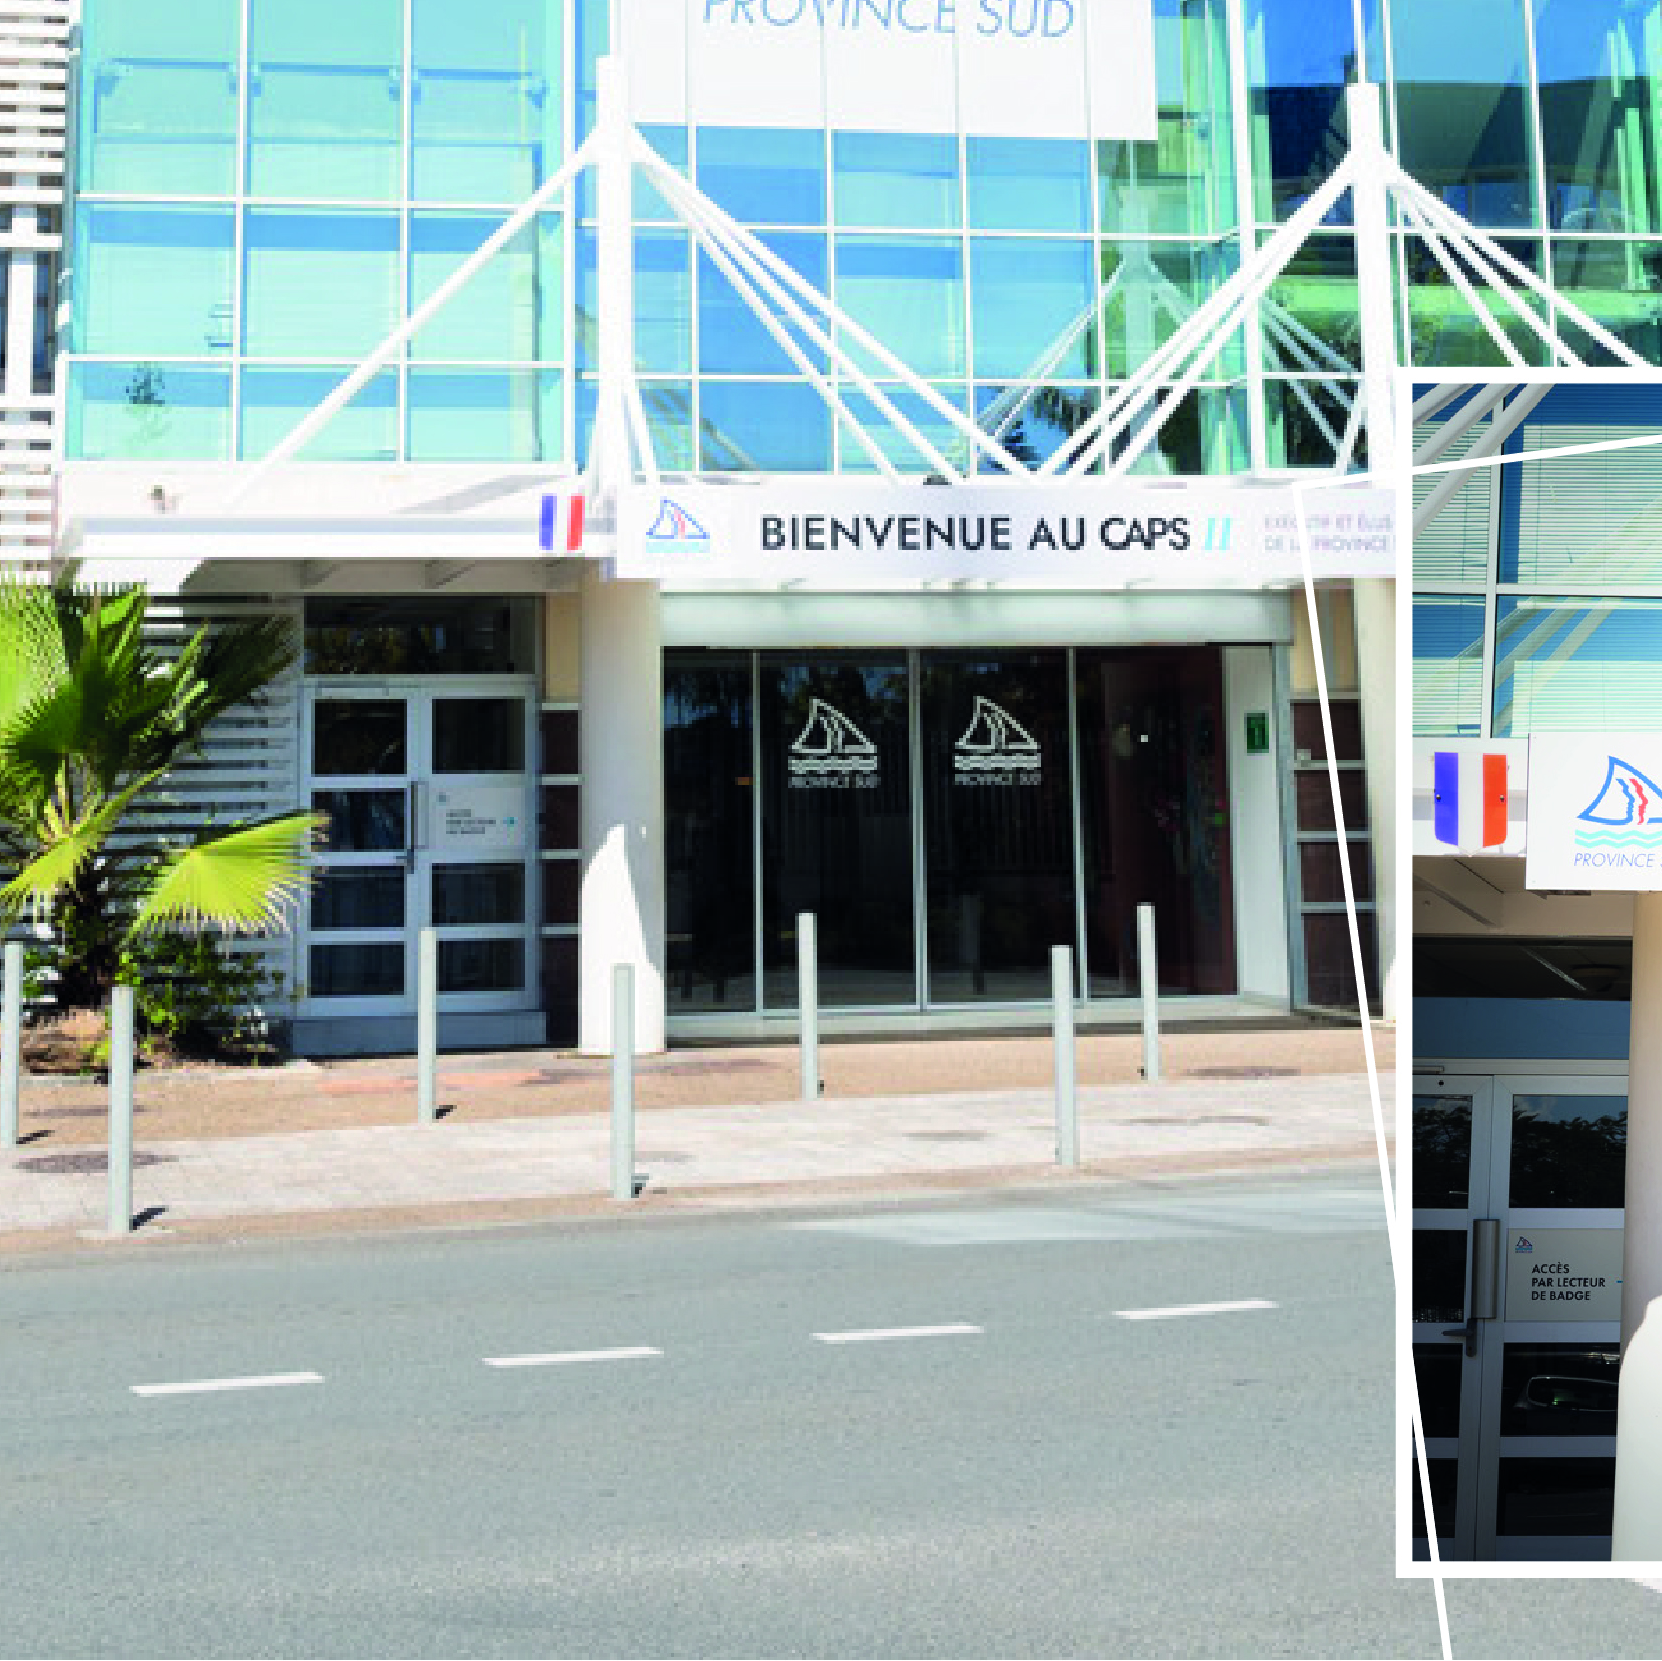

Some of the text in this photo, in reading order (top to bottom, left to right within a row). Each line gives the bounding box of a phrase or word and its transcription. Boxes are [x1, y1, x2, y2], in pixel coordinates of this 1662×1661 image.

[760, 515, 1012, 550] BIENVENUE
[1028, 516, 1086, 550] AU
[1099, 516, 1190, 550] CAPS
[1573, 853, 1656, 867] PROVINCE
[1531, 1261, 1570, 1274] ACCÈS
[1531, 1277, 1606, 1288] PAR LECTEUR
[1531, 1290, 1592, 1301] DE BADGE
